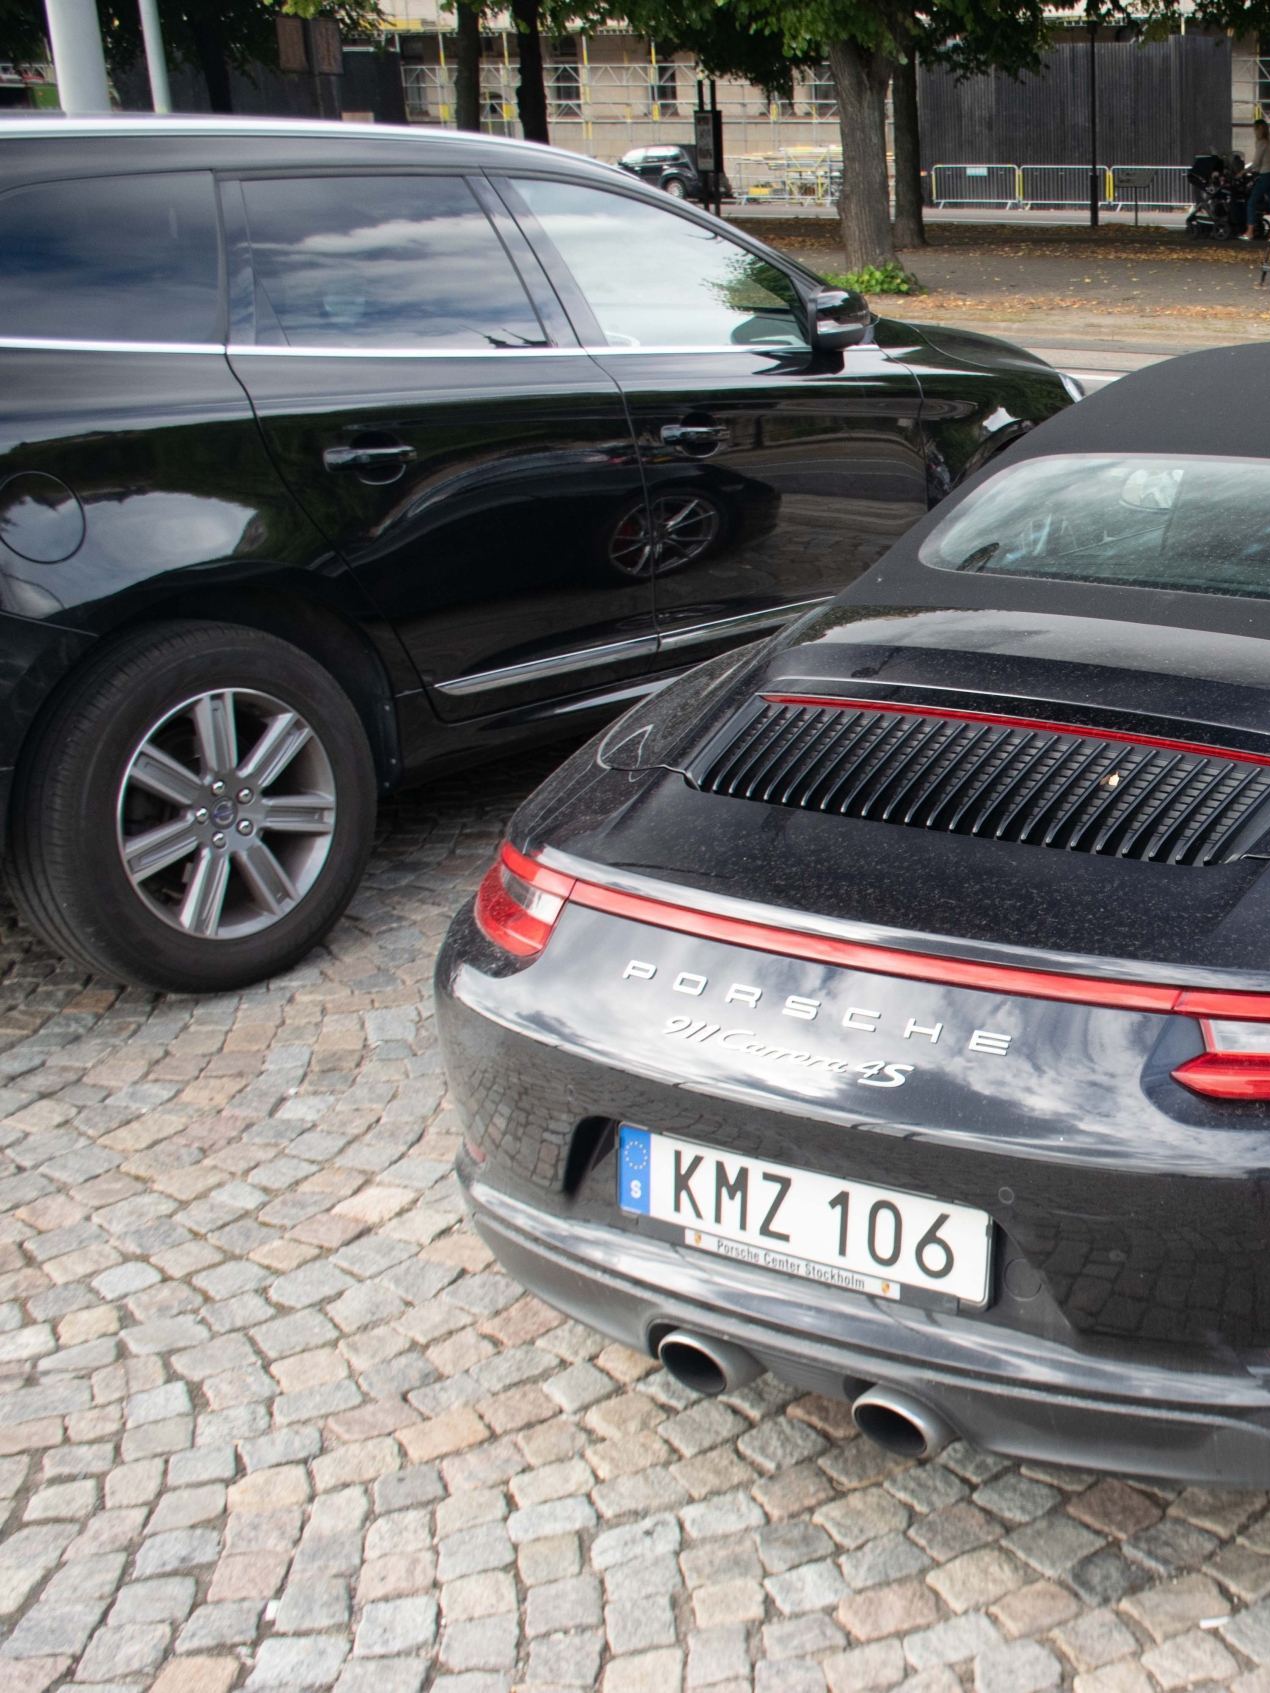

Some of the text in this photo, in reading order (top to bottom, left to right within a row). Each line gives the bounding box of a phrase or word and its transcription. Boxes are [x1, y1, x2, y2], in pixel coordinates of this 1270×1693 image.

[622, 959, 1013, 1056] PORSCHE
[662, 1015, 916, 1088] 911 Carrera 4S
[630, 1179, 642, 1199] S
[673, 1149, 955, 1279] KMZ 106
[717, 1238, 866, 1290] Porsche Center Stockholm
